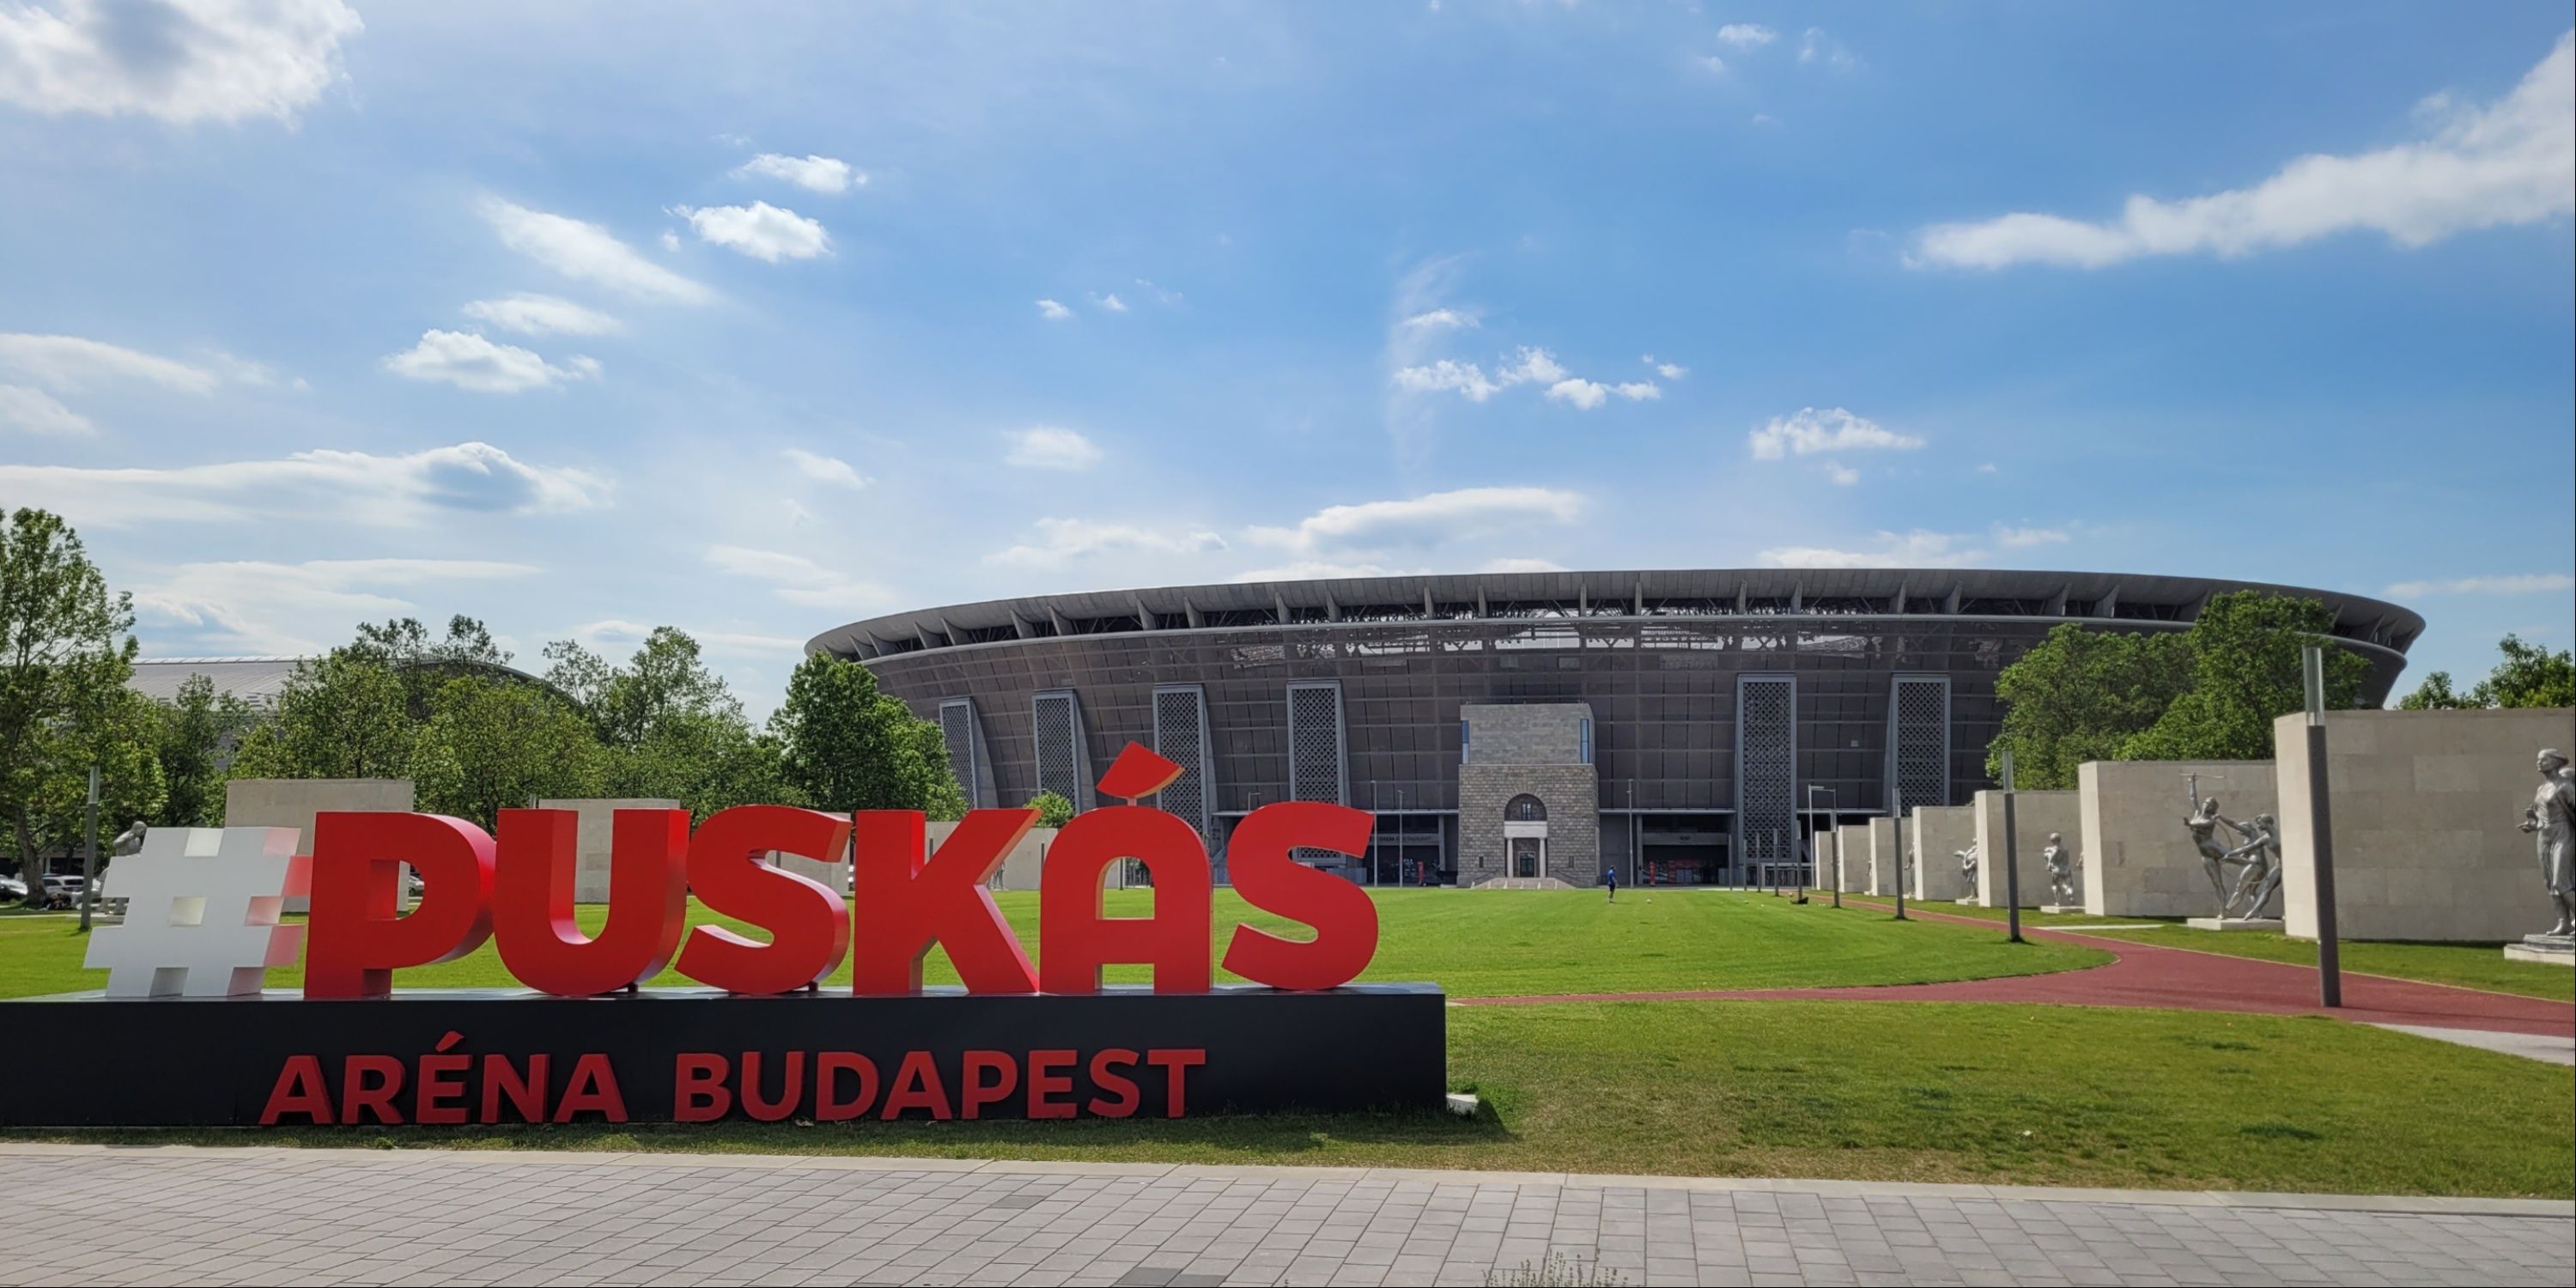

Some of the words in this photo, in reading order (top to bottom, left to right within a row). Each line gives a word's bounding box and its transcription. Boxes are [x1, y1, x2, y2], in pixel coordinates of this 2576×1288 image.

[83, 741, 1378, 998] #PUSKÁS
[259, 1030, 628, 1124] ARÉNA
[673, 1048, 1206, 1122] BUDAPEST
